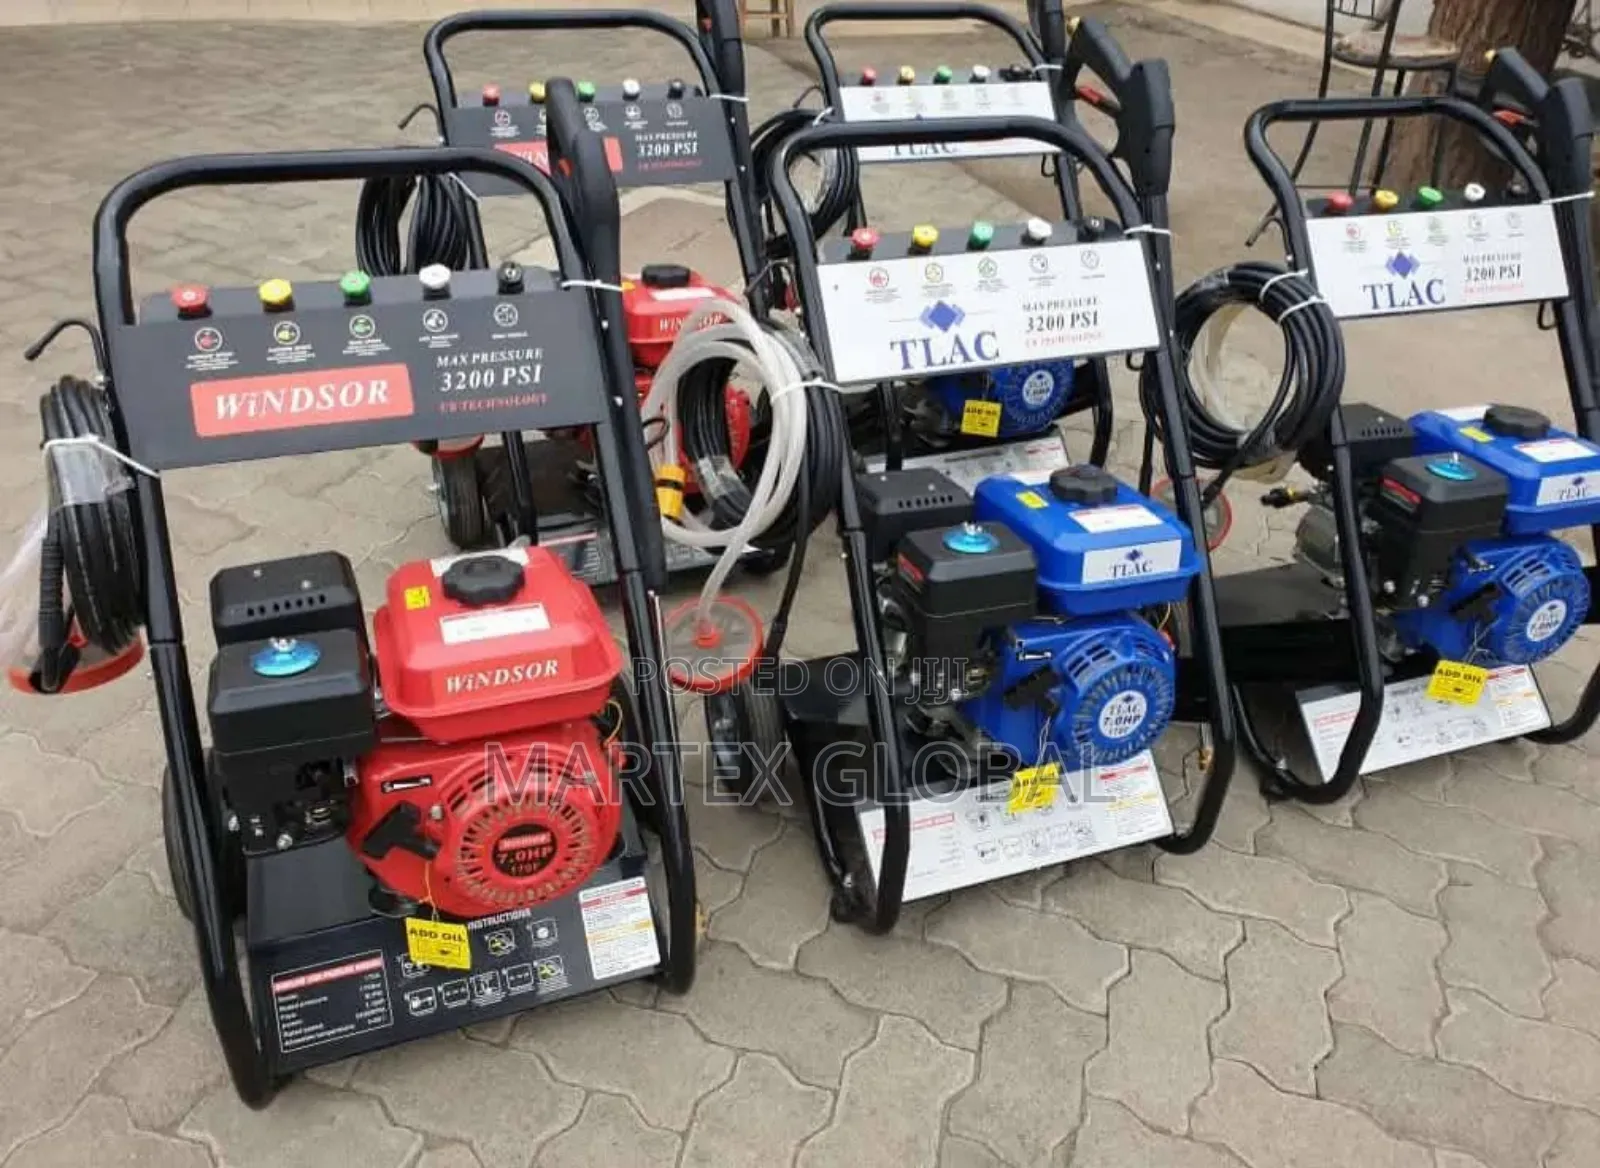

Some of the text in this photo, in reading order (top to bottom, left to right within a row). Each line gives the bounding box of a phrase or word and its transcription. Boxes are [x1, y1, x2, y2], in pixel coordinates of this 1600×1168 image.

[674, 141, 698, 157] PSI
[1500, 263, 1521, 281] PSI
[1363, 278, 1446, 310] TLAC
[1025, 309, 1099, 333] 3200 PSI
[436, 347, 544, 368] MAX PRESSURE
[890, 331, 1001, 371] TLAC
[440, 363, 542, 392] 3200 PSI
[1109, 559, 1153, 578] TLAC
[496, 846, 554, 865] 7.0HP
[408, 926, 439, 939] ADD
